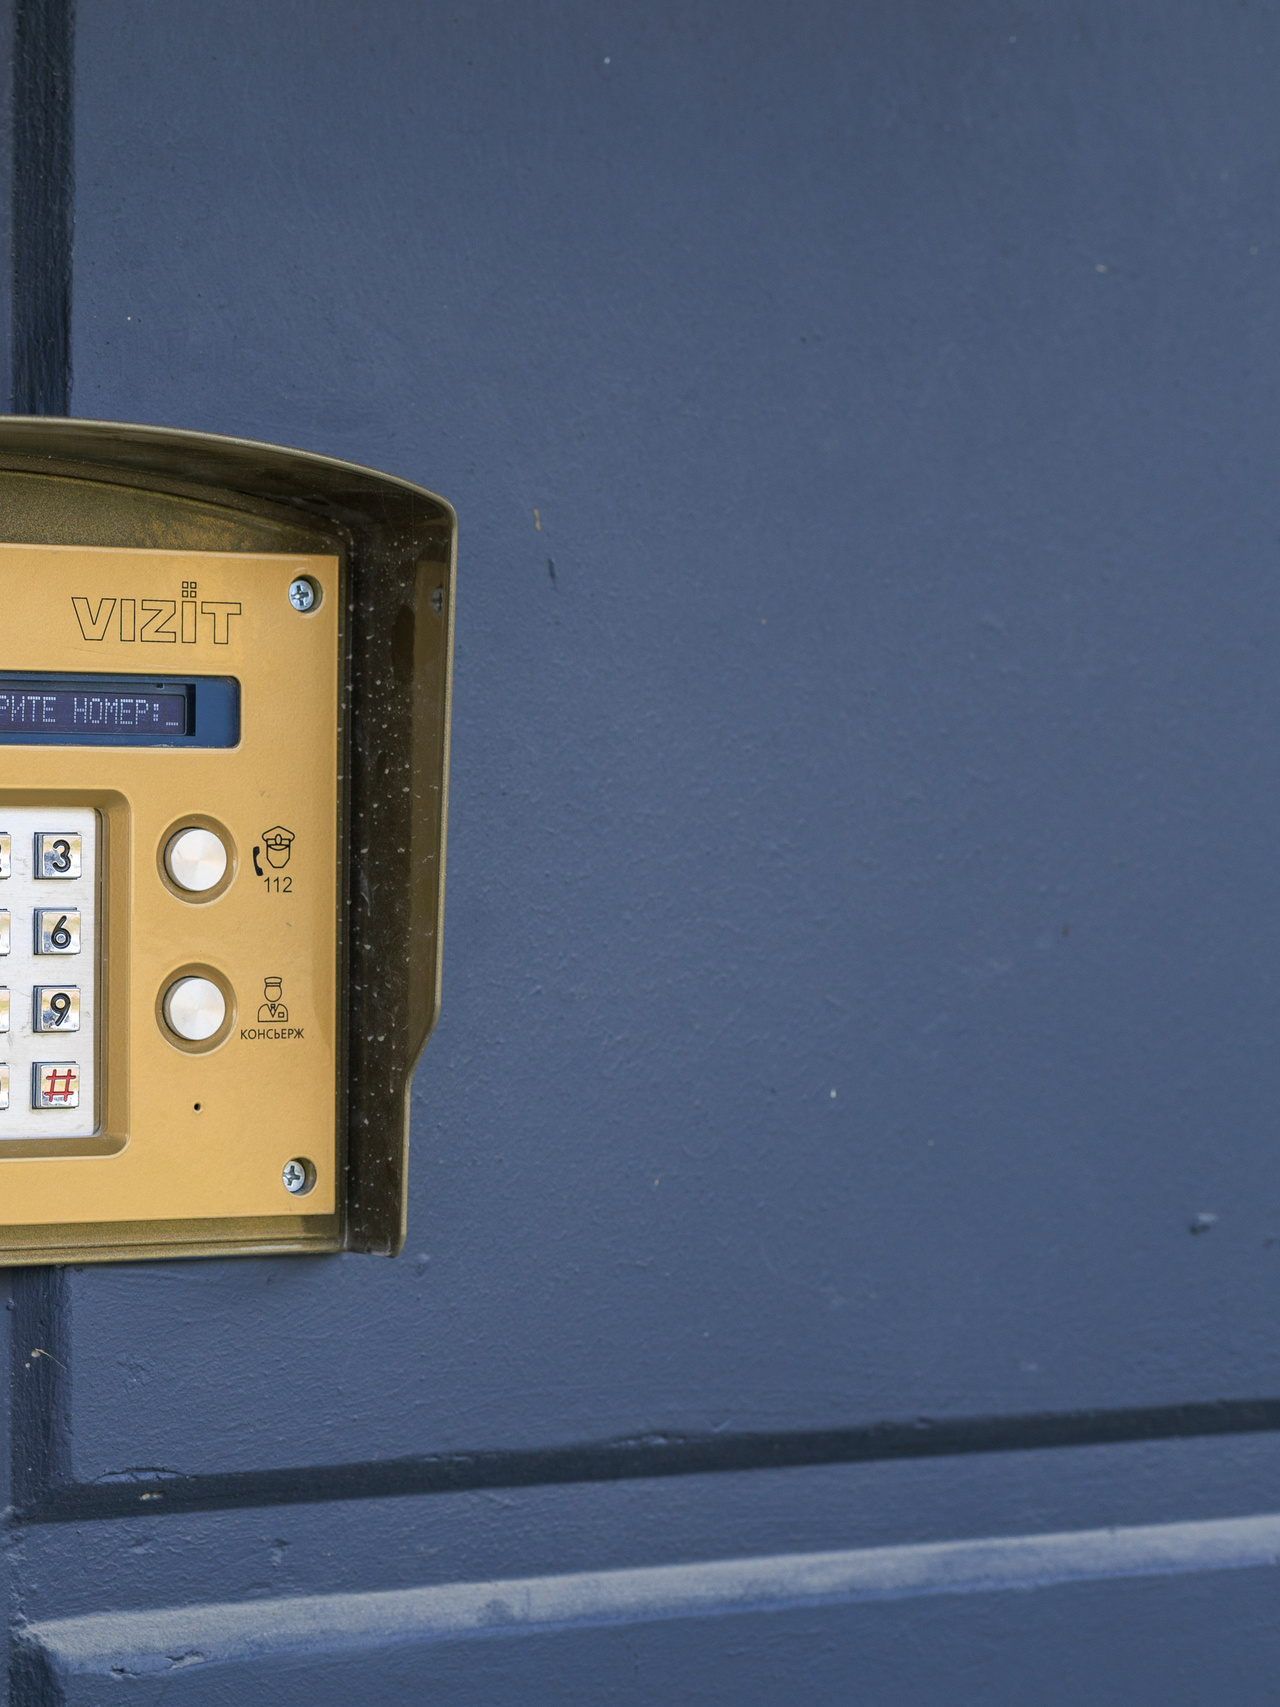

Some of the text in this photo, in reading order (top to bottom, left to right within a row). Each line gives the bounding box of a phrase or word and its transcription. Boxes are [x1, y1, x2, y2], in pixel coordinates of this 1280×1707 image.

[52, 839, 72, 873] 3
[263, 876, 293, 893] 112
[50, 915, 72, 949] 6
[50, 992, 71, 1027] 9
[240, 1028, 305, 1040] КОНСЬЕРЖ
